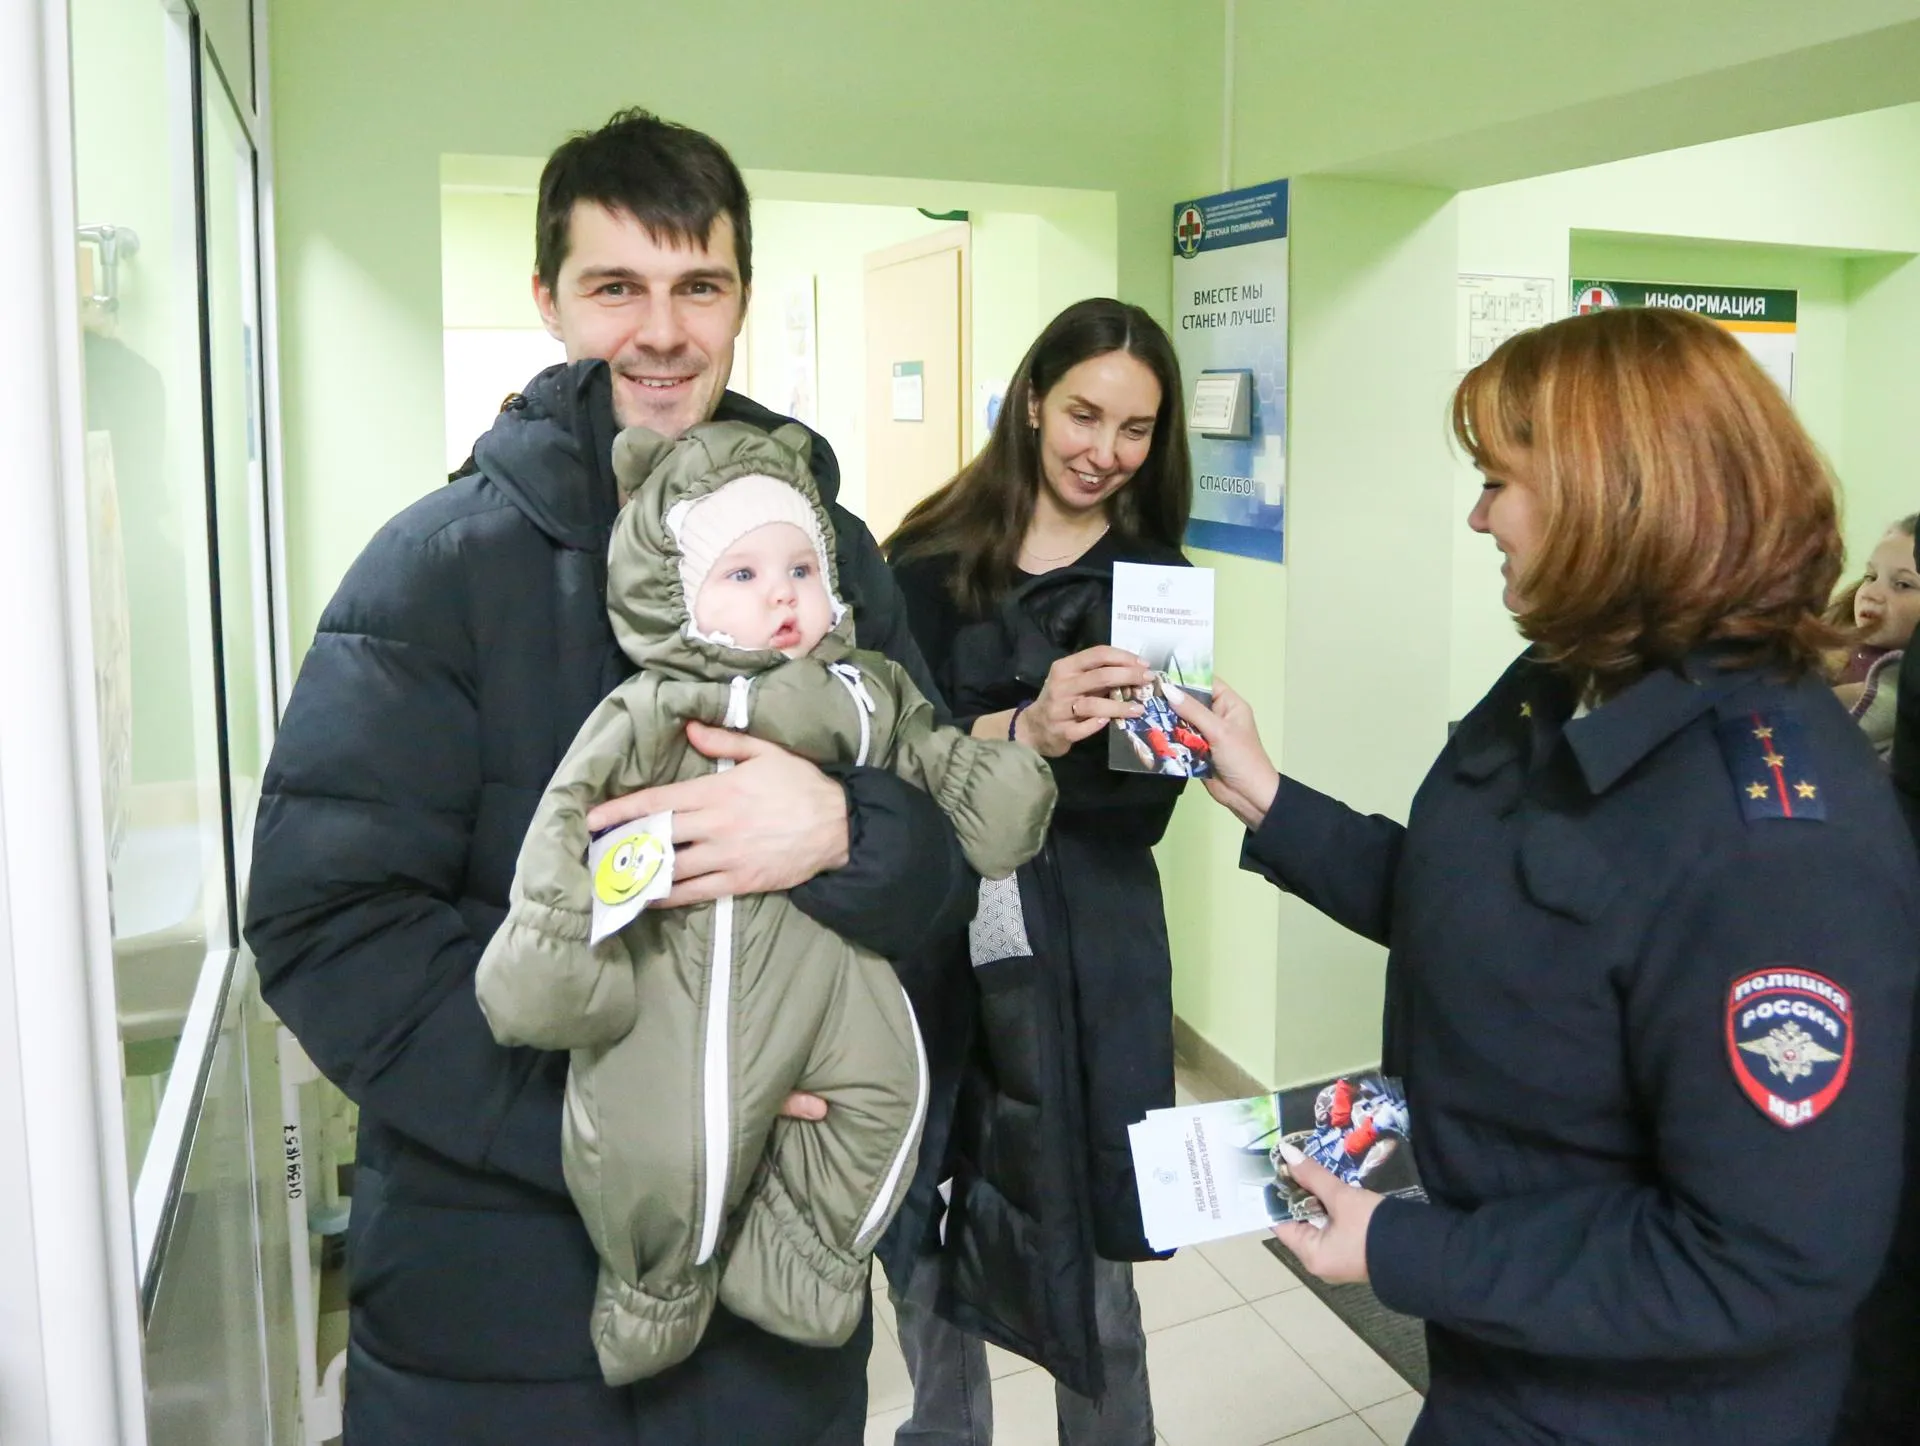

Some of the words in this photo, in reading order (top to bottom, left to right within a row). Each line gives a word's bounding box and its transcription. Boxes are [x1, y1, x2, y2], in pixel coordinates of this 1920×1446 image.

[1205, 226, 1230, 240] ДЕТСКАЯ
[1194, 286, 1238, 306] ВМЕСТЕ
[1242, 284, 1263, 300] МЫ
[1645, 291, 1766, 318] ИНФОРМАЦИЯ
[1182, 312, 1226, 330] СТАНЕМ
[1230, 307, 1276, 326] ЛУЧШЕ!
[1199, 474, 1255, 494] СПАСИБО!
[1735, 973, 1847, 1012] ПОЛИЦИЯ
[1742, 998, 1840, 1038] РОССИЯ
[1768, 1094, 1814, 1125] МВД
